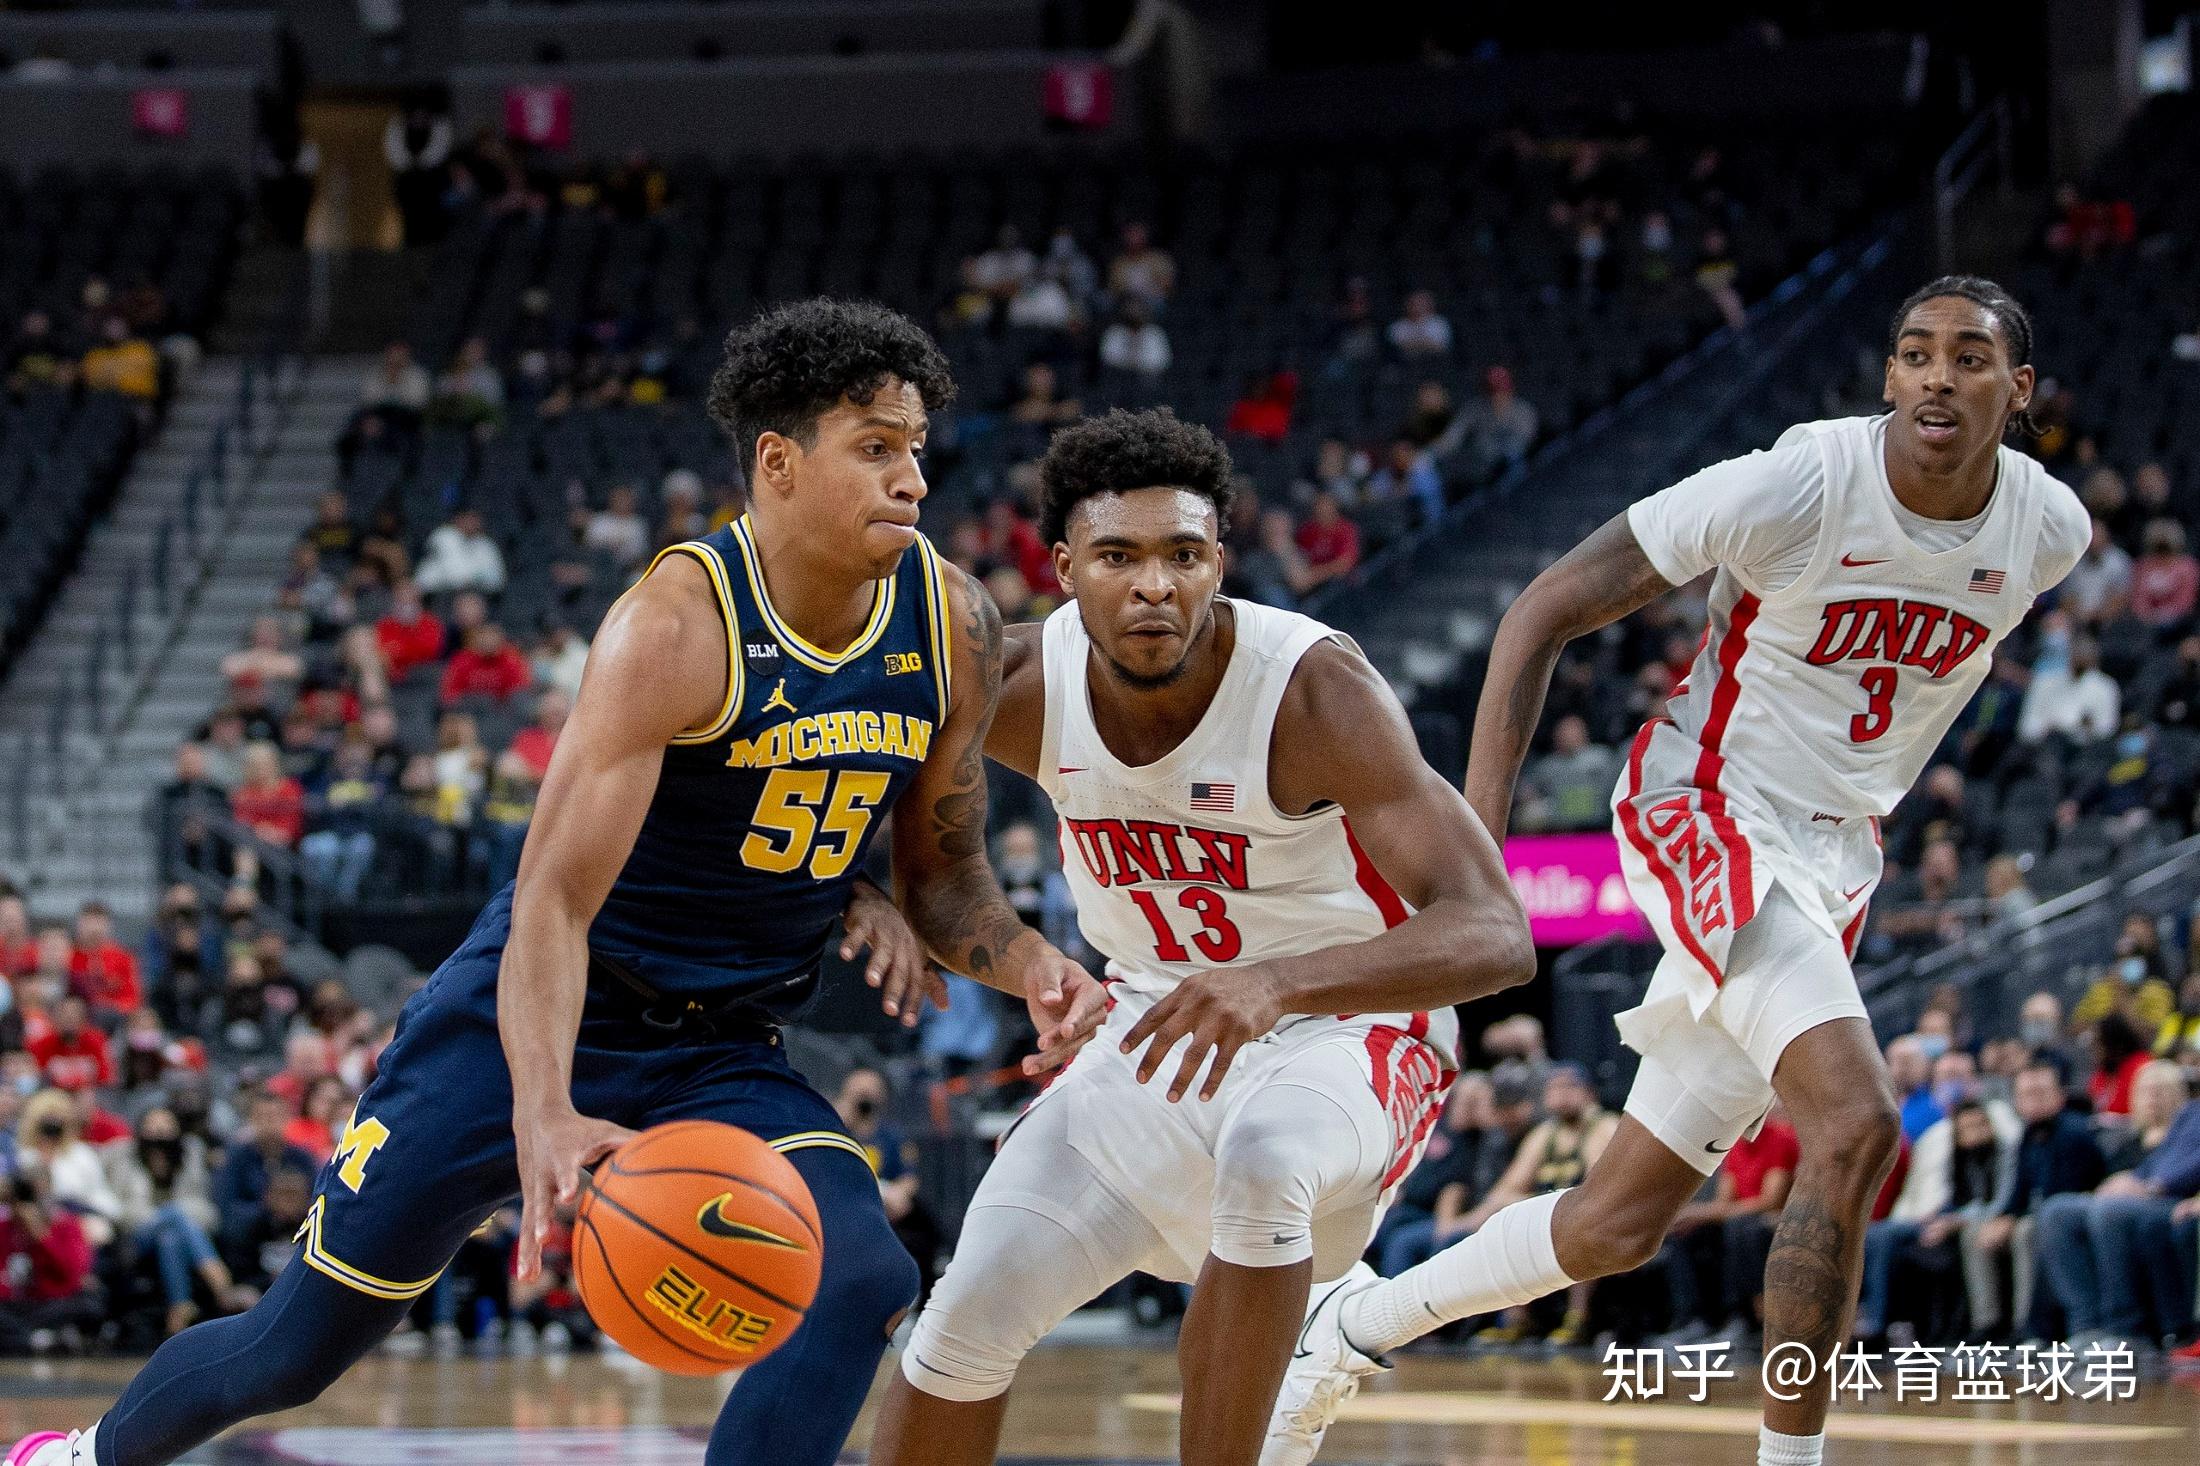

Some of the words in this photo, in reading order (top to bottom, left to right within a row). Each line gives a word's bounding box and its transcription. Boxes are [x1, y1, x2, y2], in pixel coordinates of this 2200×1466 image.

[746, 644, 779, 658] BLM
[1806, 598, 1992, 679] UNLV
[725, 711, 932, 768] MICHIGAN
[1850, 667, 1898, 743] 3
[739, 768, 892, 879] 55
[1065, 816, 1253, 891] UNLV
[1646, 794, 1728, 938] UNLV
[1128, 886, 1242, 962] 13
[332, 1095, 390, 1194] M
[649, 1262, 775, 1347] ELITE
